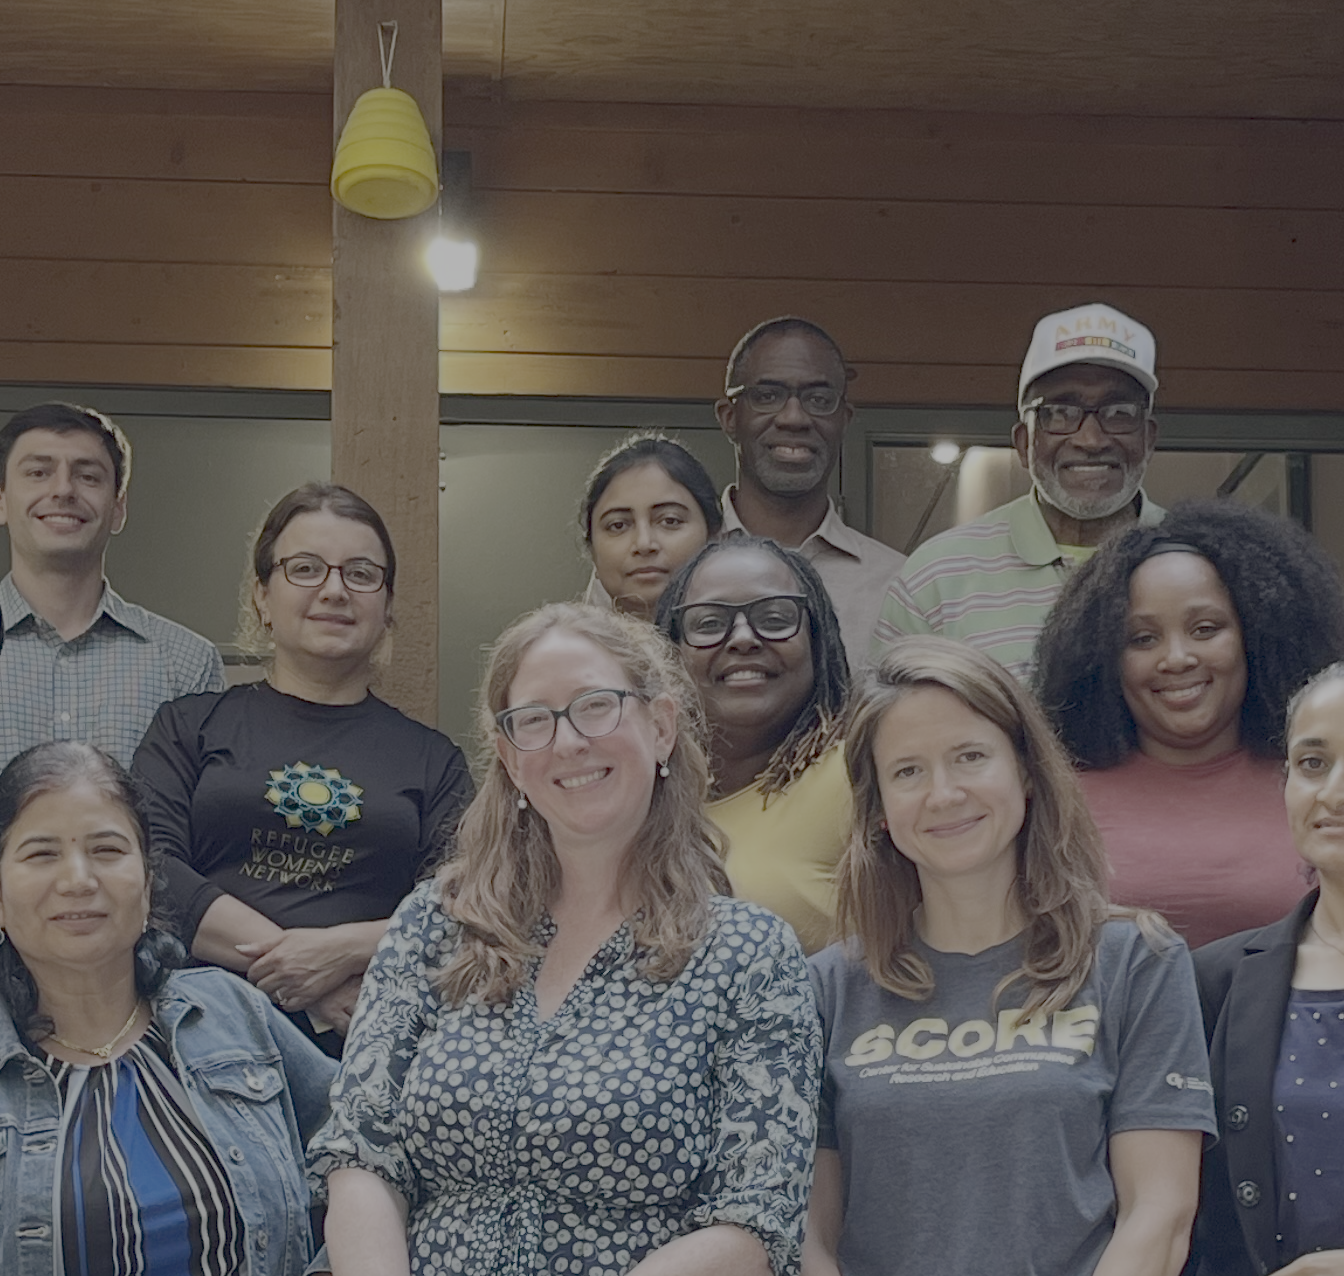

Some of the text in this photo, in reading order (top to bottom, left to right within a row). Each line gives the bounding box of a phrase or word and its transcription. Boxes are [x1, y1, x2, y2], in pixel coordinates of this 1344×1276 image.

[1055, 315, 1136, 343] ARMY
[251, 828, 355, 864] REFUGEE
[238, 861, 336, 892] NETWORK
[859, 1064, 901, 1079] Center
[901, 1062, 921, 1073] for
[920, 1057, 993, 1072] Sustainable
[889, 1061, 1040, 1084] Research and Education
